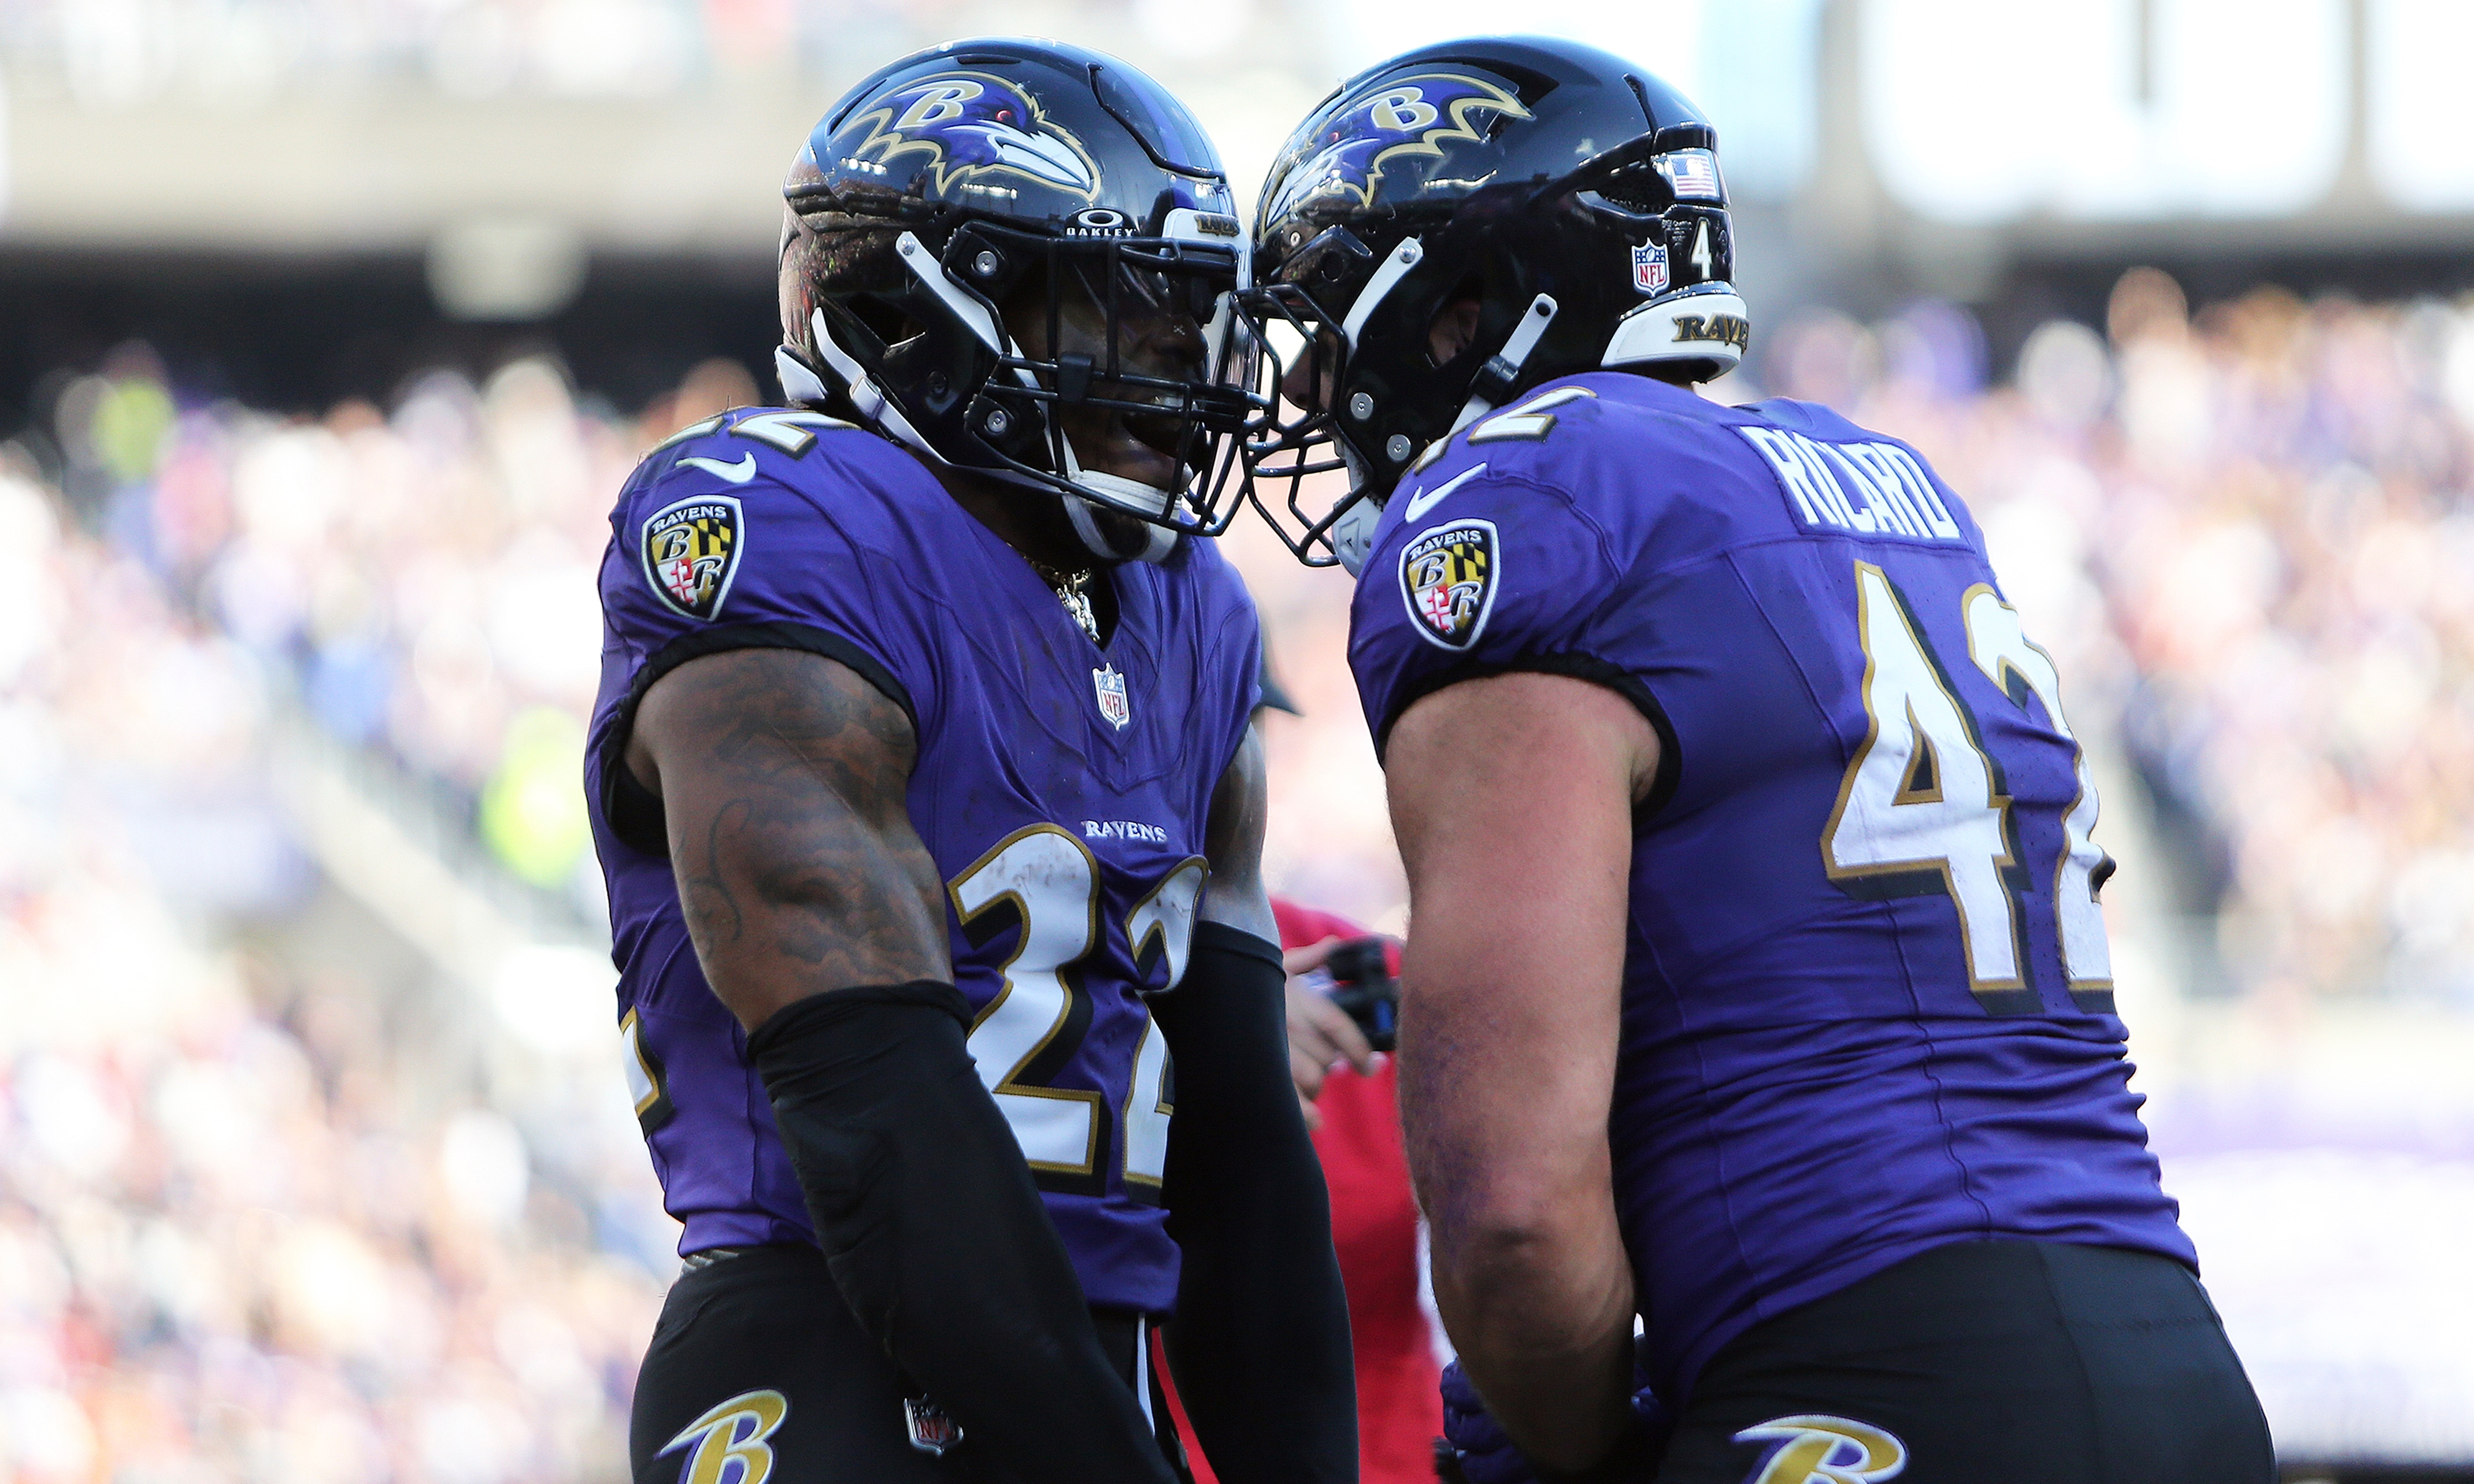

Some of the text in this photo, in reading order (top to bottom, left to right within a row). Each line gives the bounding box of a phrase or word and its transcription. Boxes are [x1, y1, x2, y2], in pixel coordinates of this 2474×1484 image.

[1066, 228, 1134, 236] OAKLEY
[1691, 220, 1712, 279] 4
[1639, 264, 1664, 285] NFL
[1739, 425, 1961, 538] RICARD
[652, 506, 727, 533] RAVENS
[1410, 530, 1483, 560] RAVENS
[1103, 692, 1124, 717] NFL
[1820, 559, 2116, 1014] 42
[1081, 821, 1167, 842] RAVENS
[947, 822, 1209, 1207] 22
